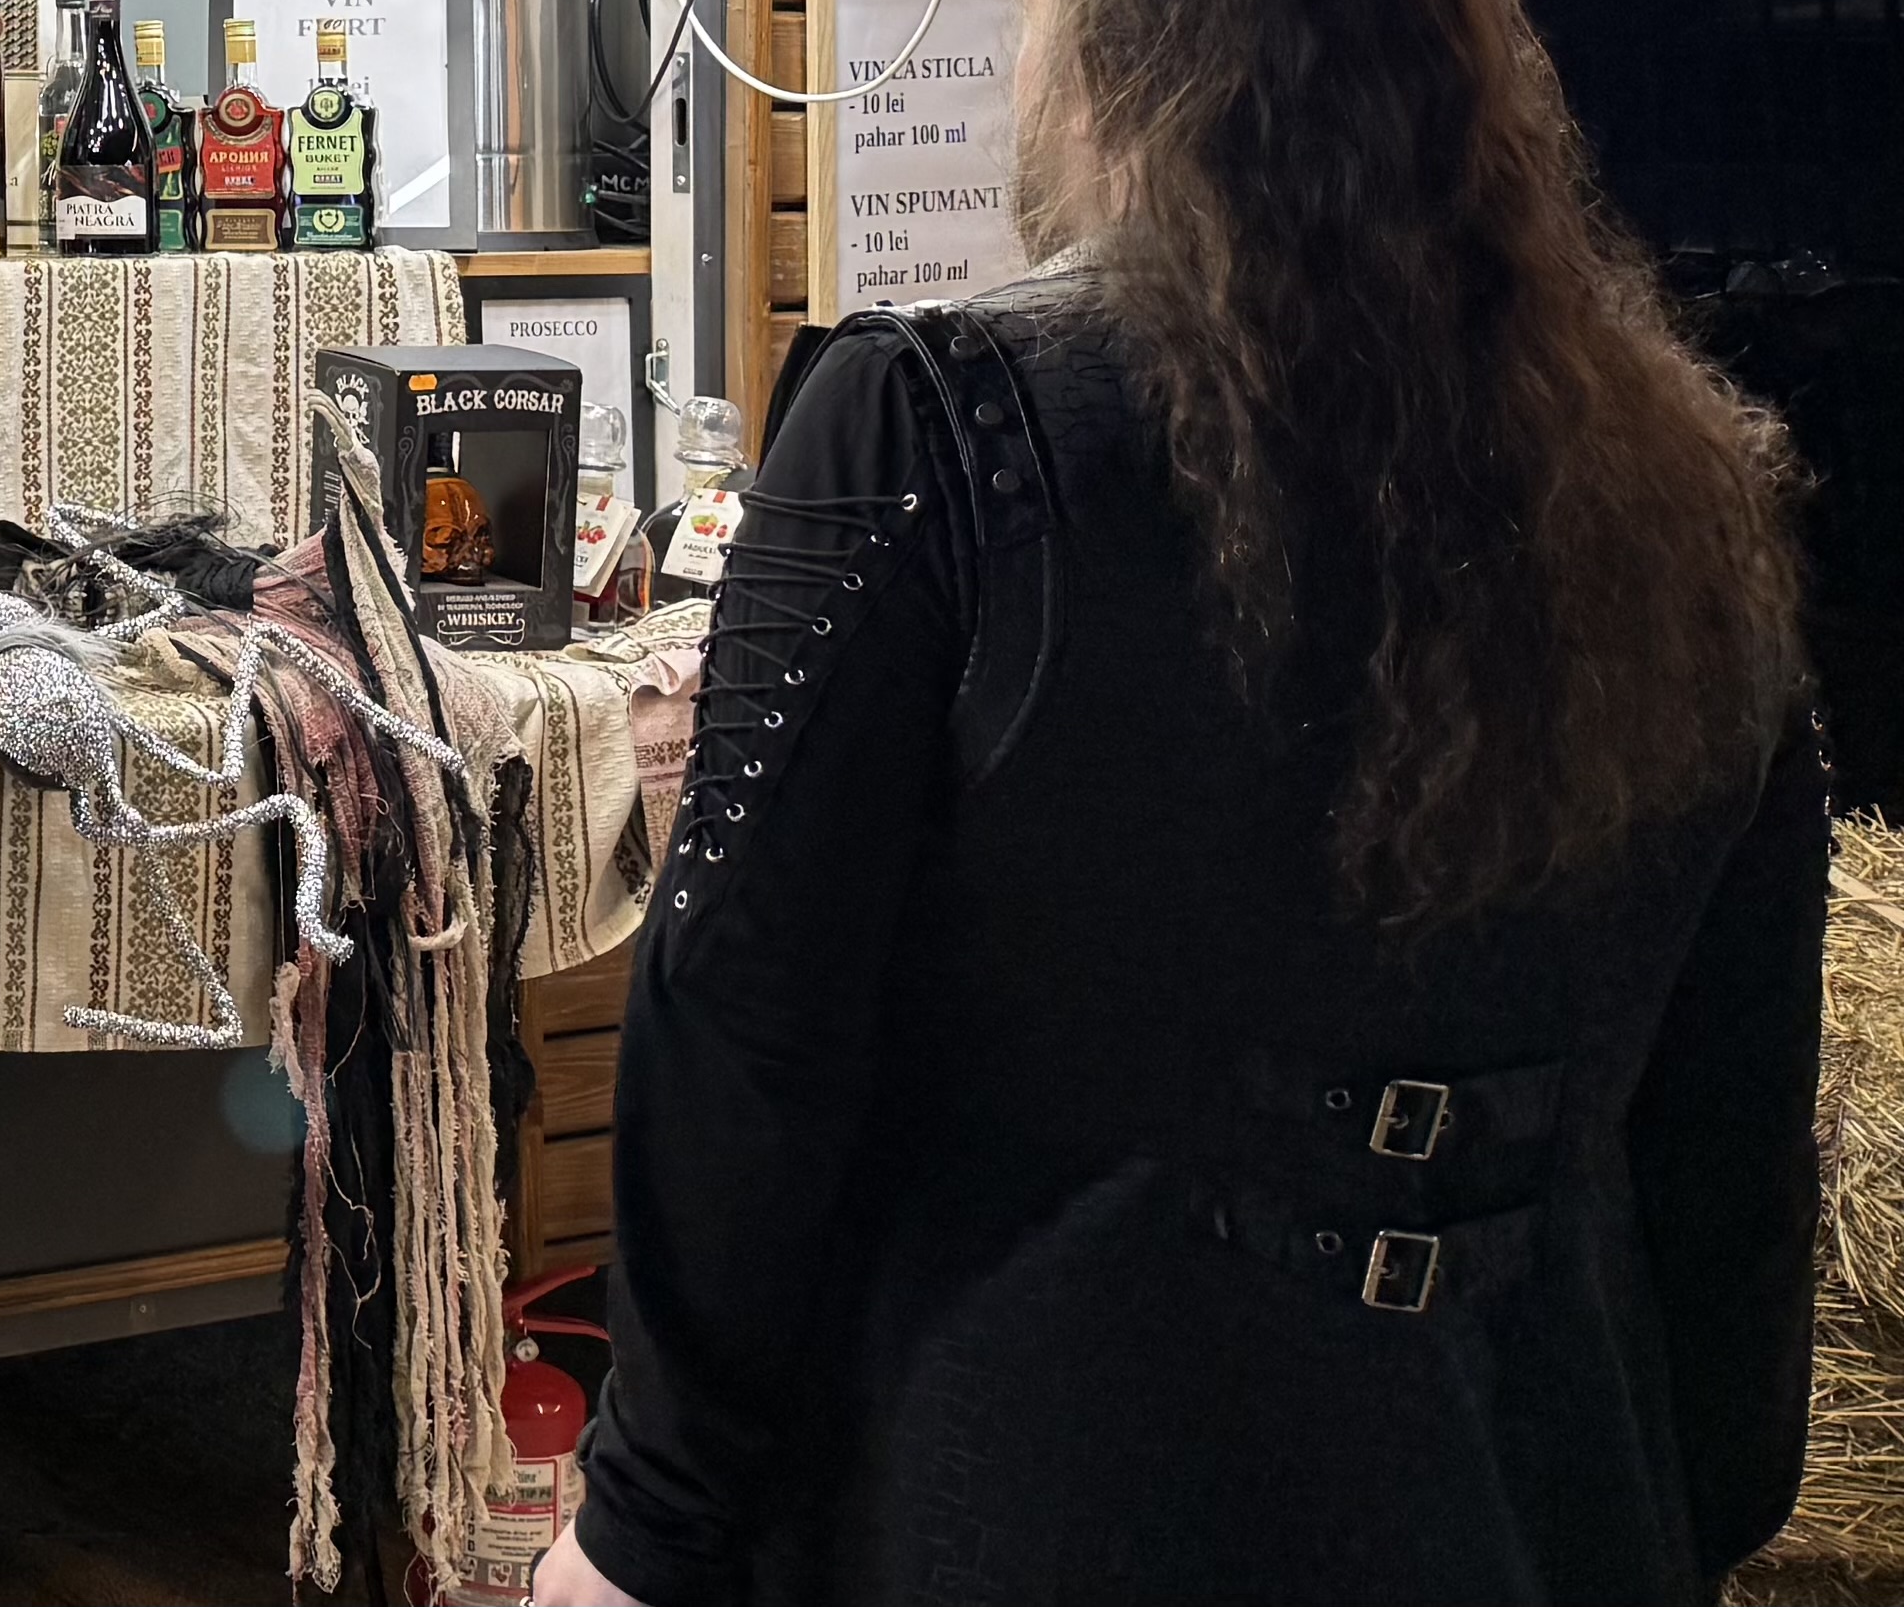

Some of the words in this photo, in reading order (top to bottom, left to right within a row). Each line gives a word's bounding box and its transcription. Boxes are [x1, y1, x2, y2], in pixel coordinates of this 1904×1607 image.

[298, 18, 386, 36] FRT
[921, 56, 994, 79] STICLA
[862, 93, 880, 115] 10
[885, 91, 905, 114] lei
[298, 136, 358, 152] FERNET
[855, 125, 906, 155] pahar
[911, 123, 940, 146] 100
[944, 121, 967, 144] ml
[209, 151, 269, 164] АРОНИЯ
[305, 154, 350, 163] BUKET
[66, 204, 114, 215] PIATRA
[850, 192, 890, 218] VIN
[895, 186, 1002, 215] SPUMANT
[865, 231, 884, 254] 10
[888, 229, 909, 252] lei
[856, 264, 909, 294] pahar
[913, 261, 942, 284] 100
[946, 258, 968, 281] ml
[509, 319, 598, 338] PROSECCO
[416, 390, 487, 416] BLACK
[494, 389, 564, 414] CORSAR
[447, 612, 515, 626] WHISKEY
